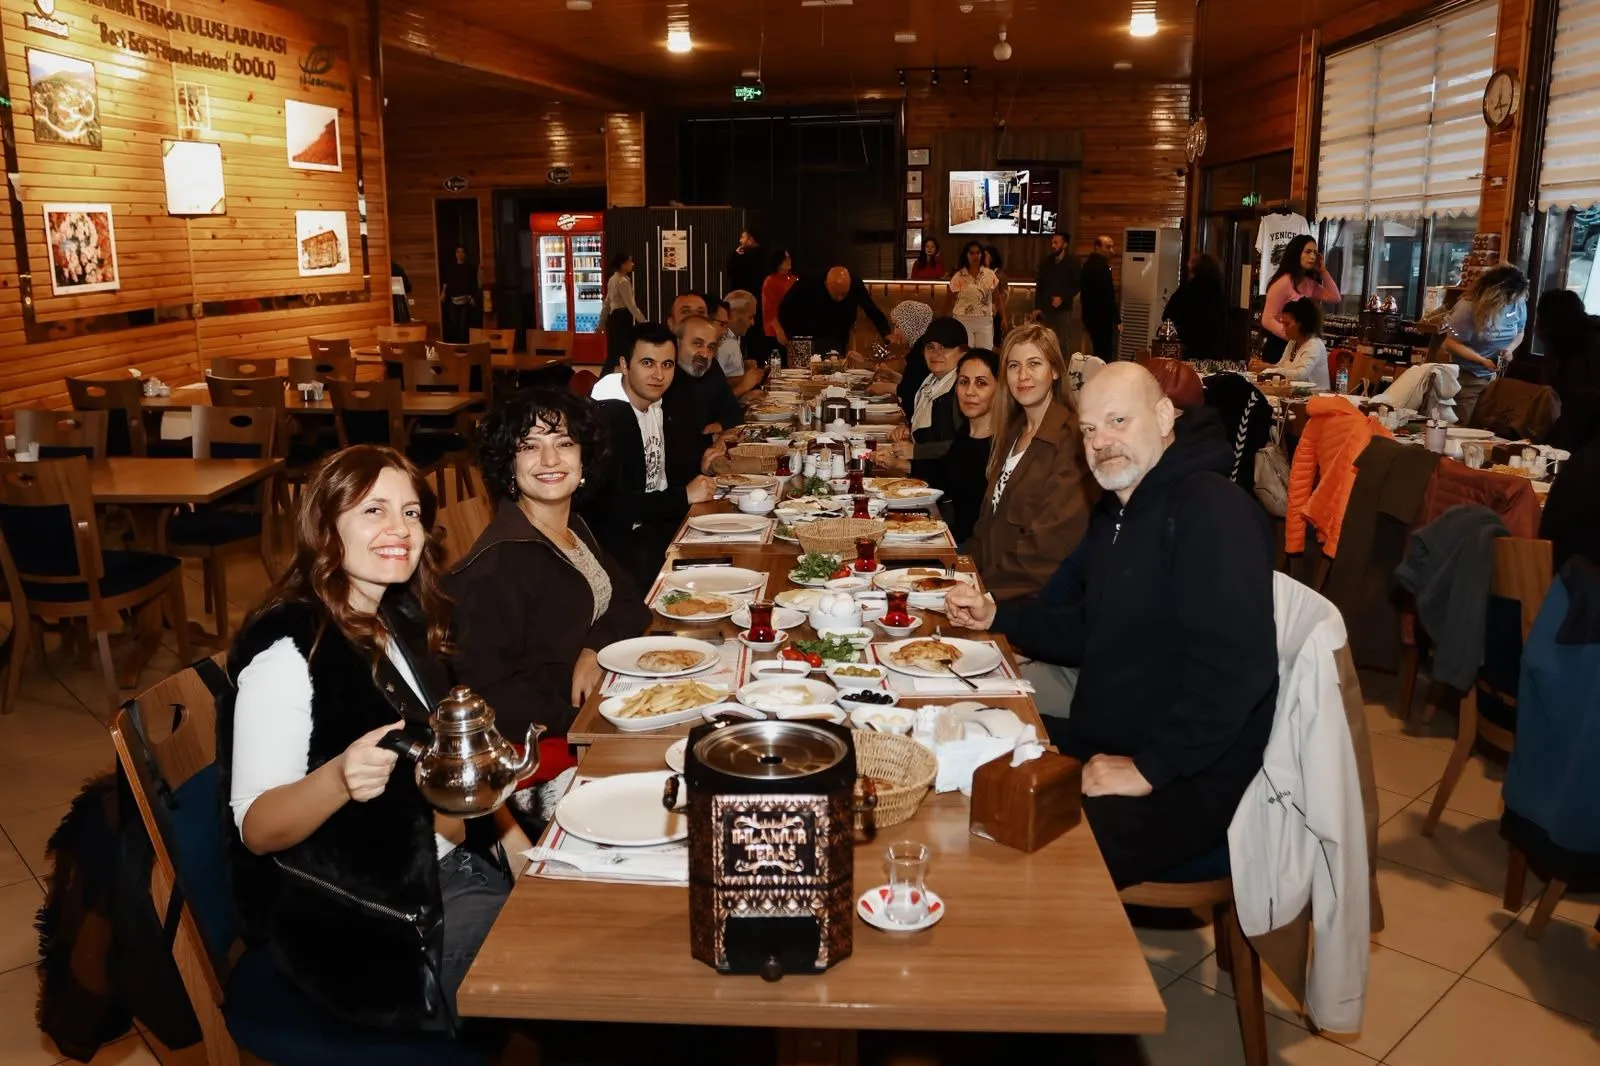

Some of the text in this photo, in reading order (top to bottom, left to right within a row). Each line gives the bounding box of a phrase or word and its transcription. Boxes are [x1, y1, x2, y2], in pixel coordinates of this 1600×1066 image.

[136, 0, 185, 32] TERASA
[186, 15, 287, 55] ULUSLARARASI
[233, 53, 276, 80] ÖDÜLÜ
[744, 844, 796, 861] TERAS
